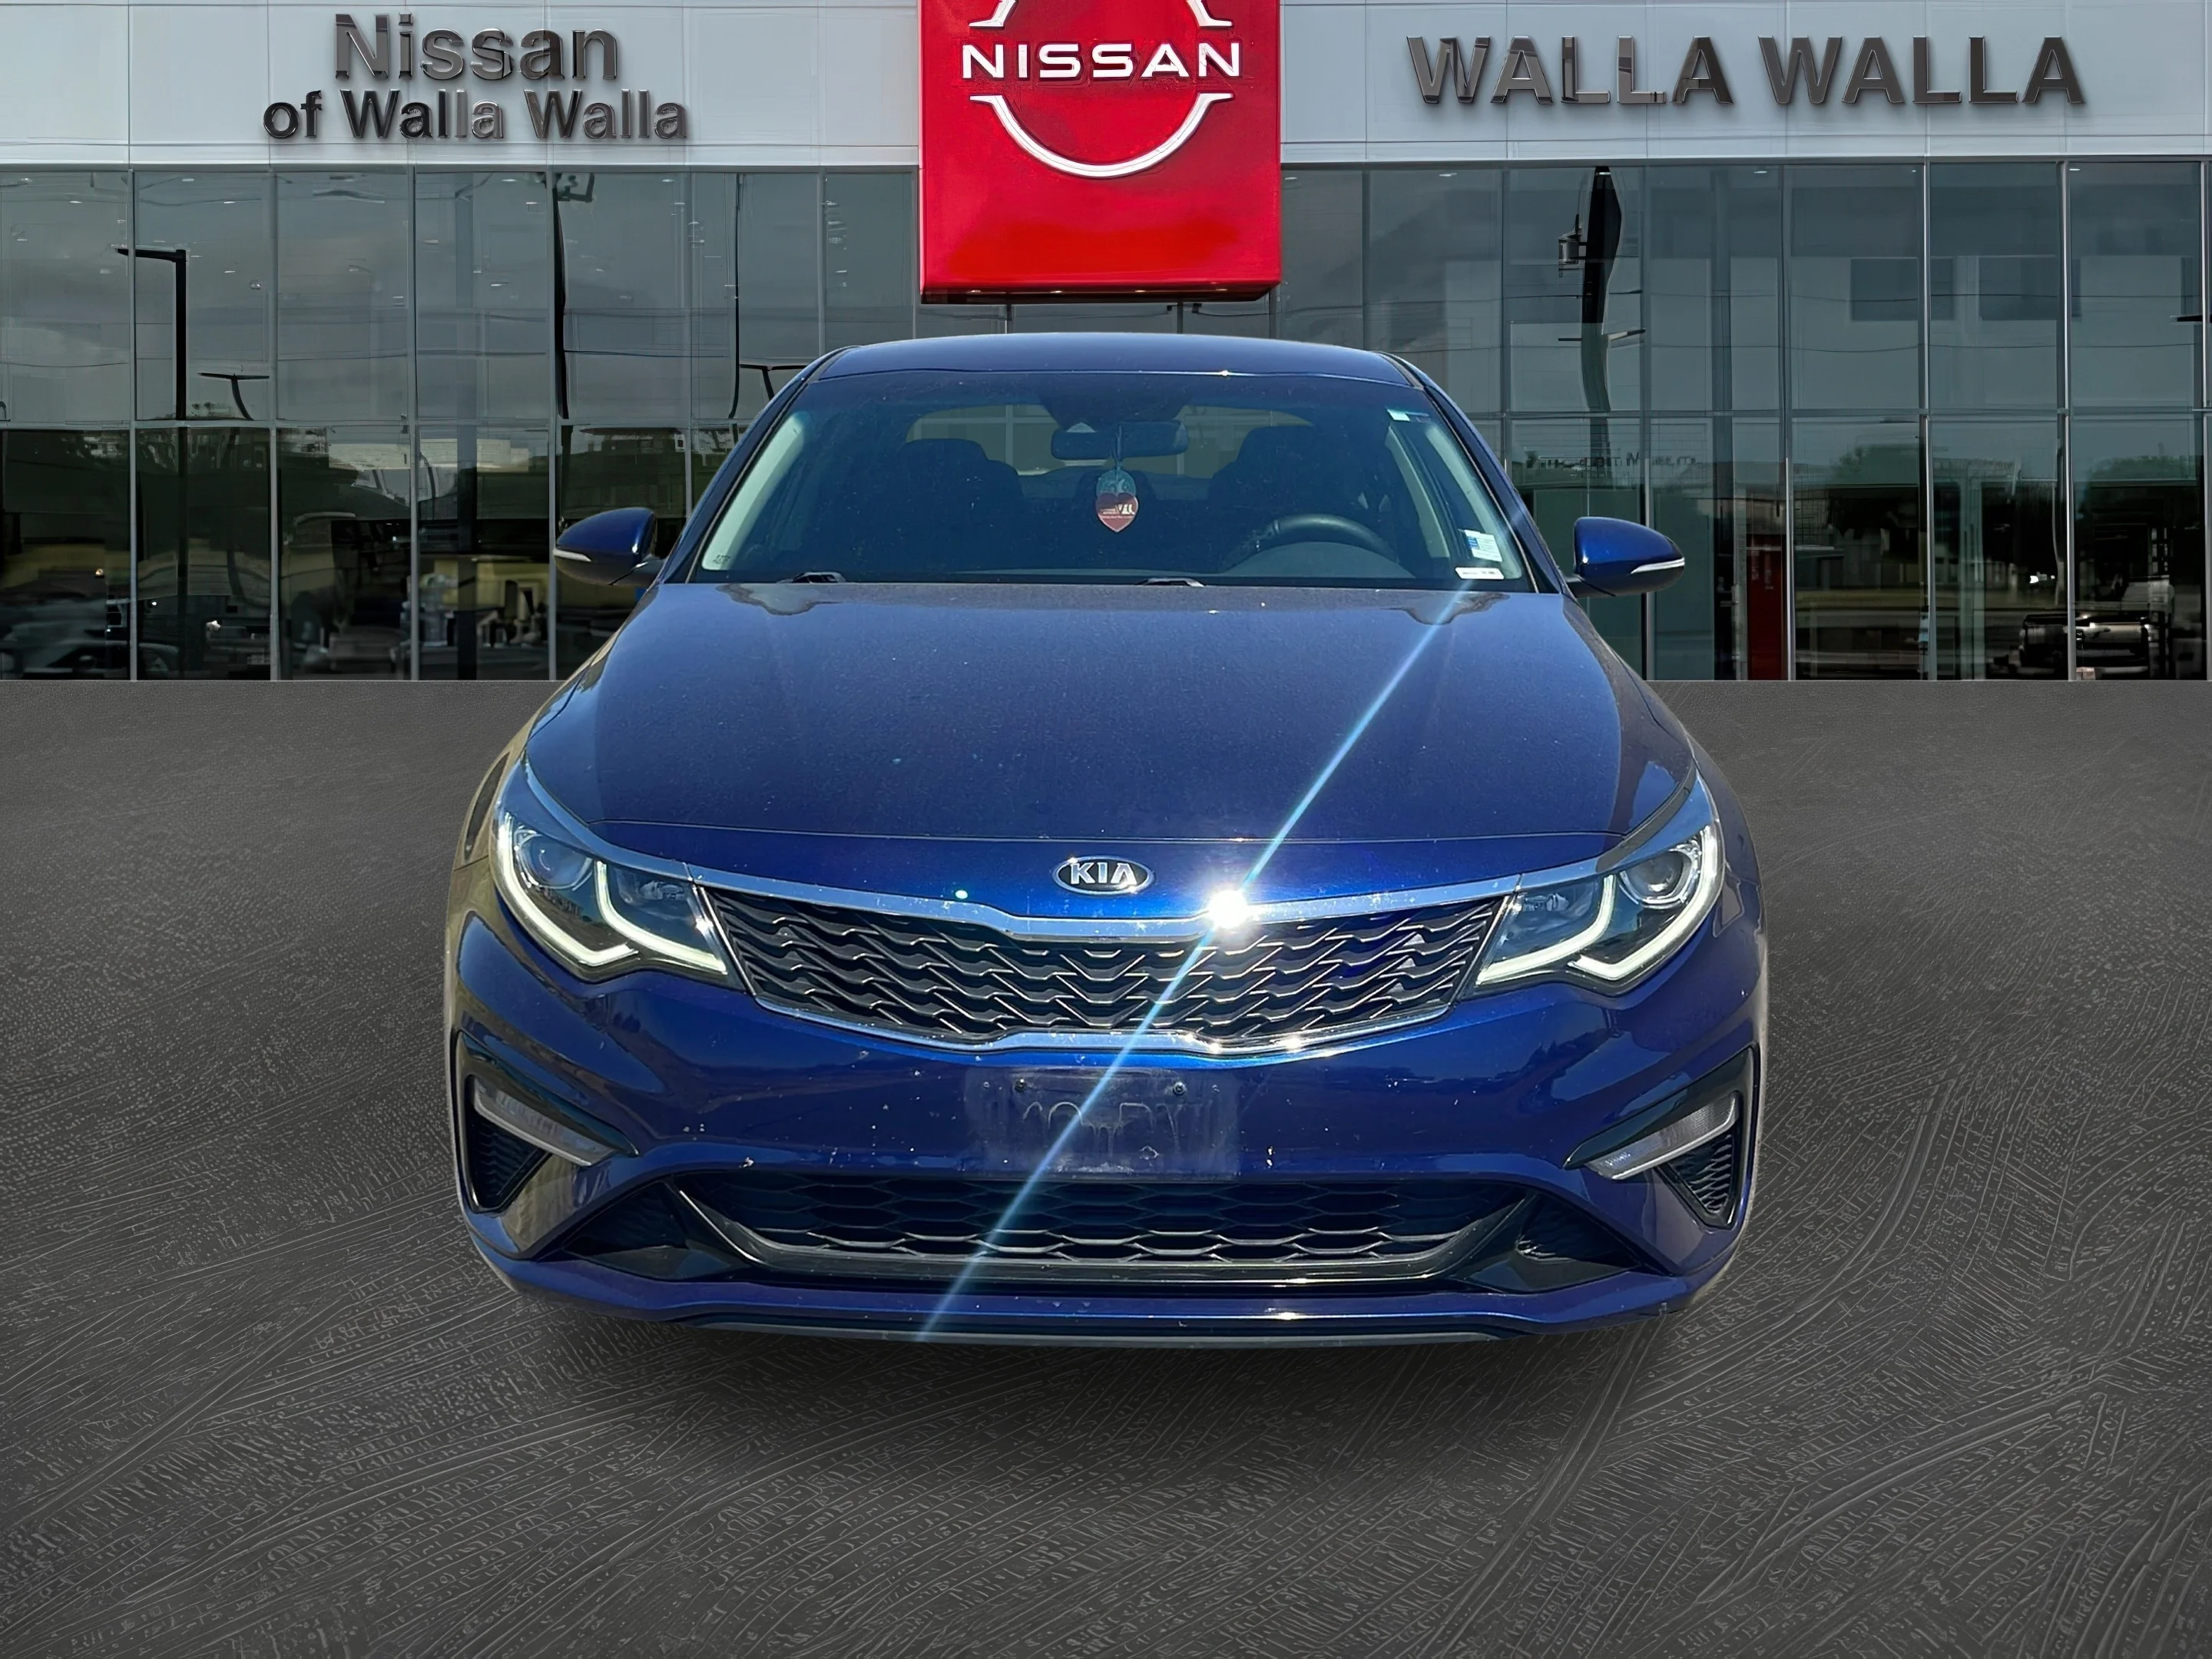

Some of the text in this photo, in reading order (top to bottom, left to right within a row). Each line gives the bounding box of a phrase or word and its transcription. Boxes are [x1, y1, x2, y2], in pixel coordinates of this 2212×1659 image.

[335, 12, 618, 80] Nissan
[962, 42, 1240, 78] NISSAN
[1406, 35, 2084, 105] WALLA WALLA
[263, 88, 687, 139] of Walla Walla
[1070, 862, 1137, 885] KIA
